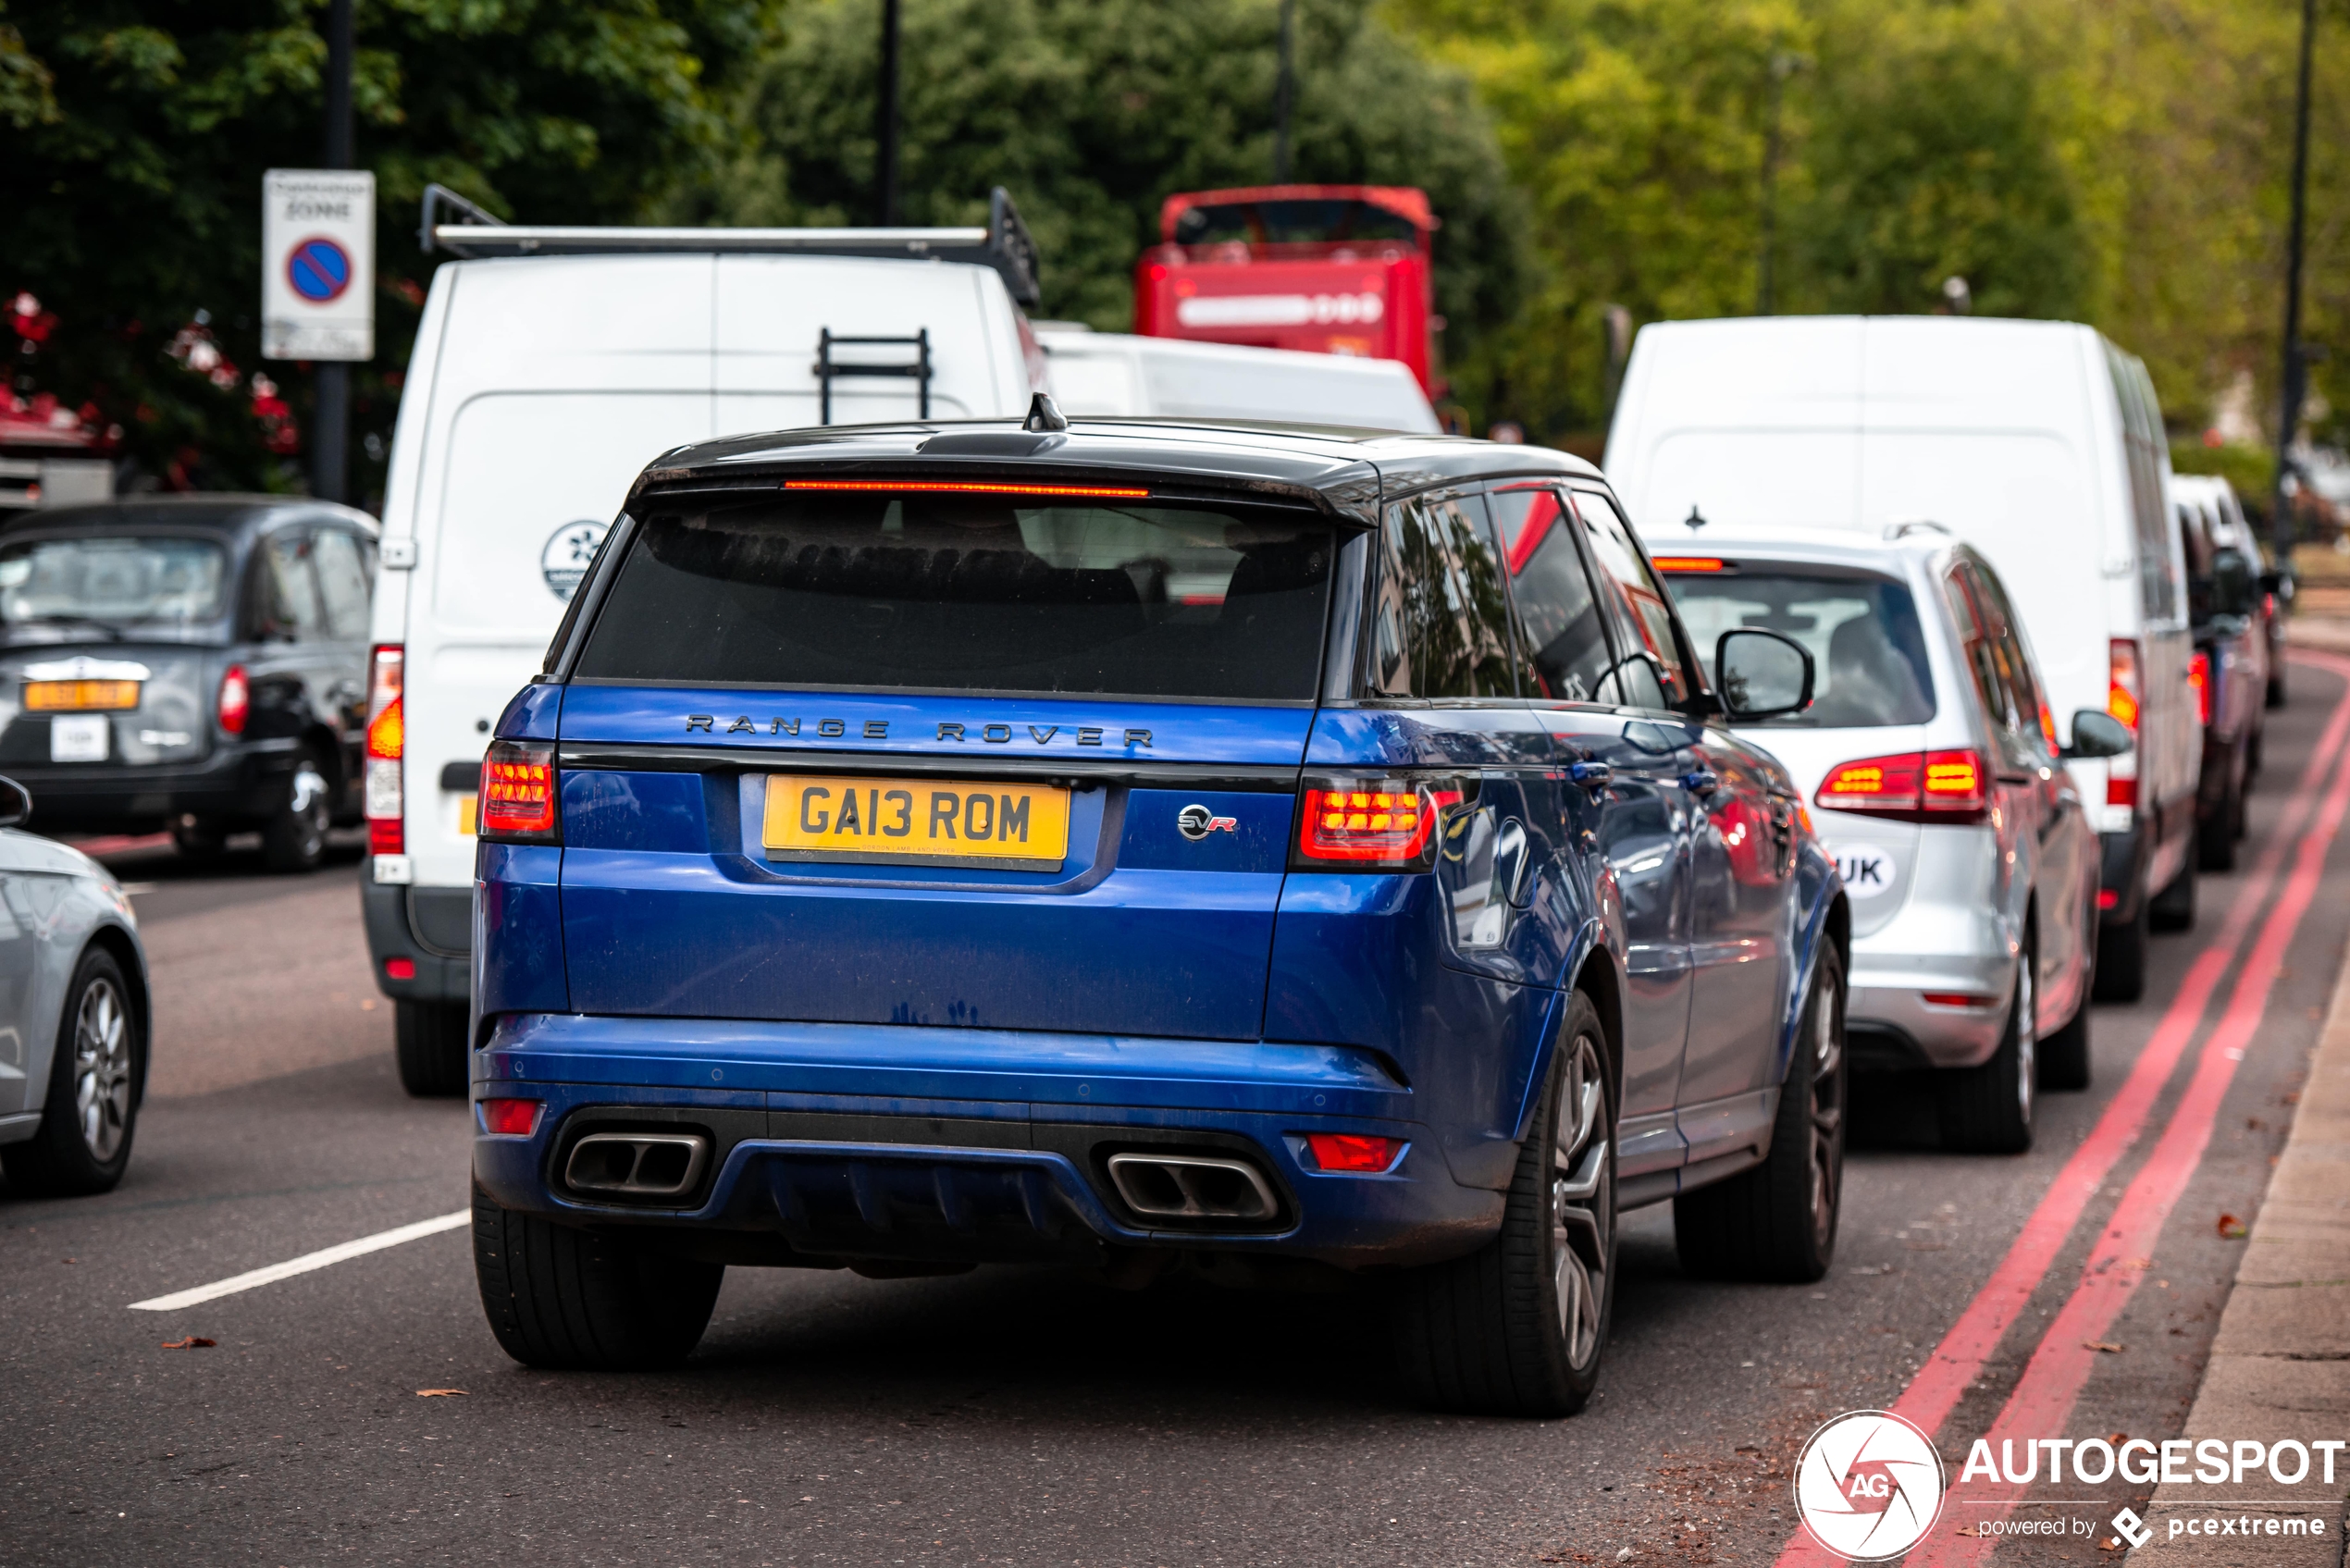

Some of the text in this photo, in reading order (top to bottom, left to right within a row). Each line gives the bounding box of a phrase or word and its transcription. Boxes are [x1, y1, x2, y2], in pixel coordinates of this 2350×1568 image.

[686, 714, 1155, 748] RANGE ROVER
[800, 786, 1032, 843] GA13 ROM
[1178, 810, 1237, 834] SVR
[1837, 858, 1882, 884] UK
